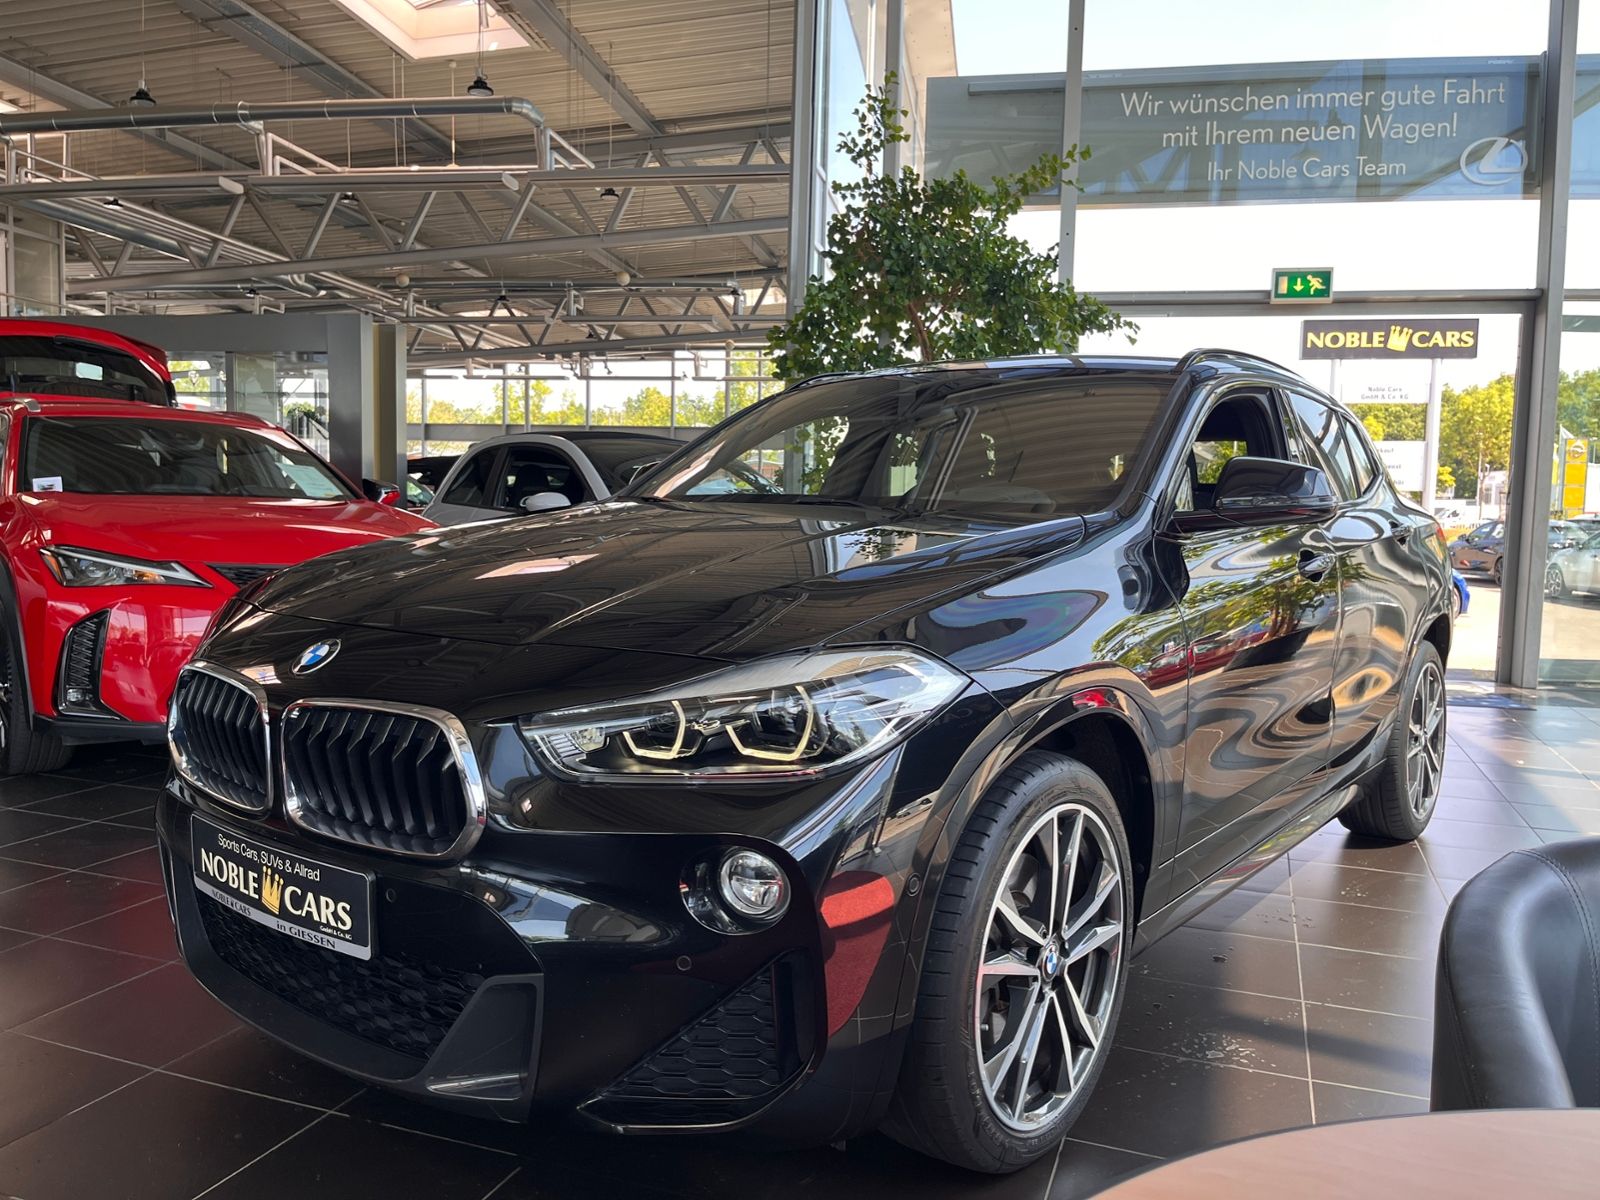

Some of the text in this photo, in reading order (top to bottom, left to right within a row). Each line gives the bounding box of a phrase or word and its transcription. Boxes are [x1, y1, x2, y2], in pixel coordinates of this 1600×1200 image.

[1121, 79, 1506, 117] Wir wünschen immer gute Fahrt
[1162, 112, 1458, 148] mit Ihrem neuen Wagen!
[1207, 156, 1406, 181] Ihr Noble Cars Team
[1306, 330, 1475, 349] NOBLE CARS
[218, 833, 320, 882] Sports Cars, SUVs & Allrad
[200, 847, 353, 931] NOBLE CARS
[276, 920, 336, 949] in GIESSEN
